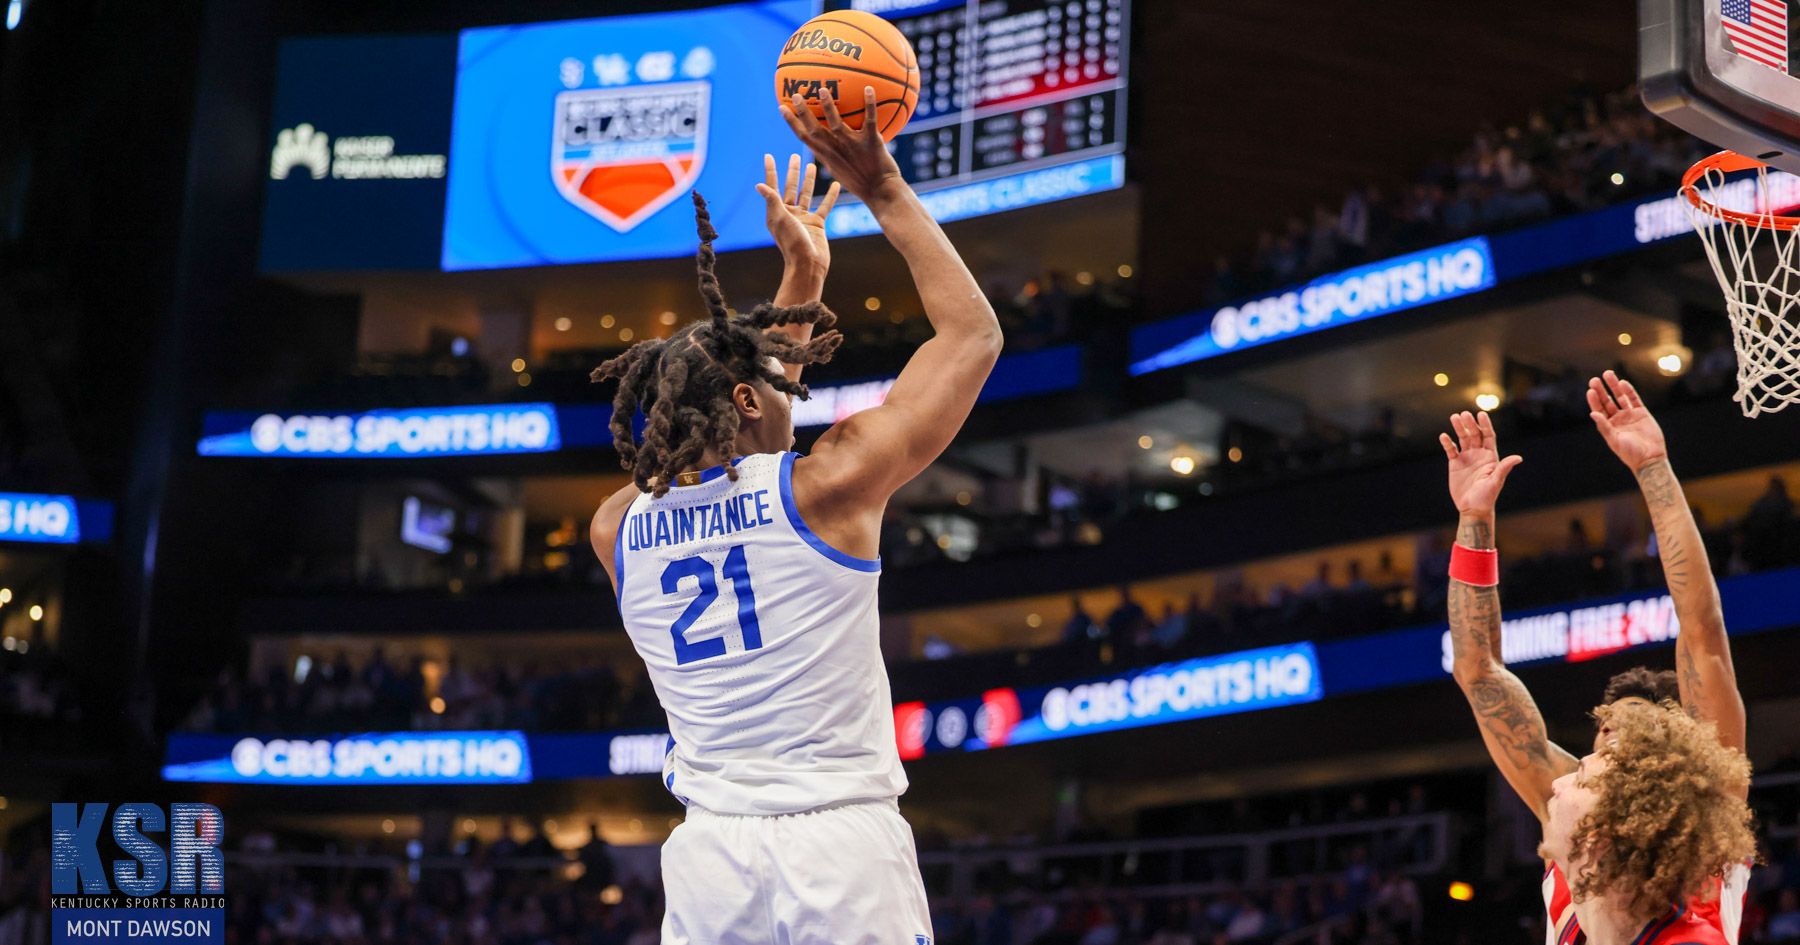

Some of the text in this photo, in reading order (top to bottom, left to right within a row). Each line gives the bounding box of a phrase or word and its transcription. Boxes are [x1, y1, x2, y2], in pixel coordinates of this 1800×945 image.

[783, 29, 862, 61] Wilson
[783, 77, 839, 101] NCAA
[1238, 247, 1484, 341] CBS SPORTS HQ
[281, 411, 550, 453] CBS SPORTS HQ
[14, 500, 70, 537] HQ
[628, 489, 773, 551] QUAINTANCE
[660, 544, 763, 666] 21
[1069, 653, 1311, 726] CBS SPORTS HQ
[263, 738, 522, 777] CBS SPORTS HQ
